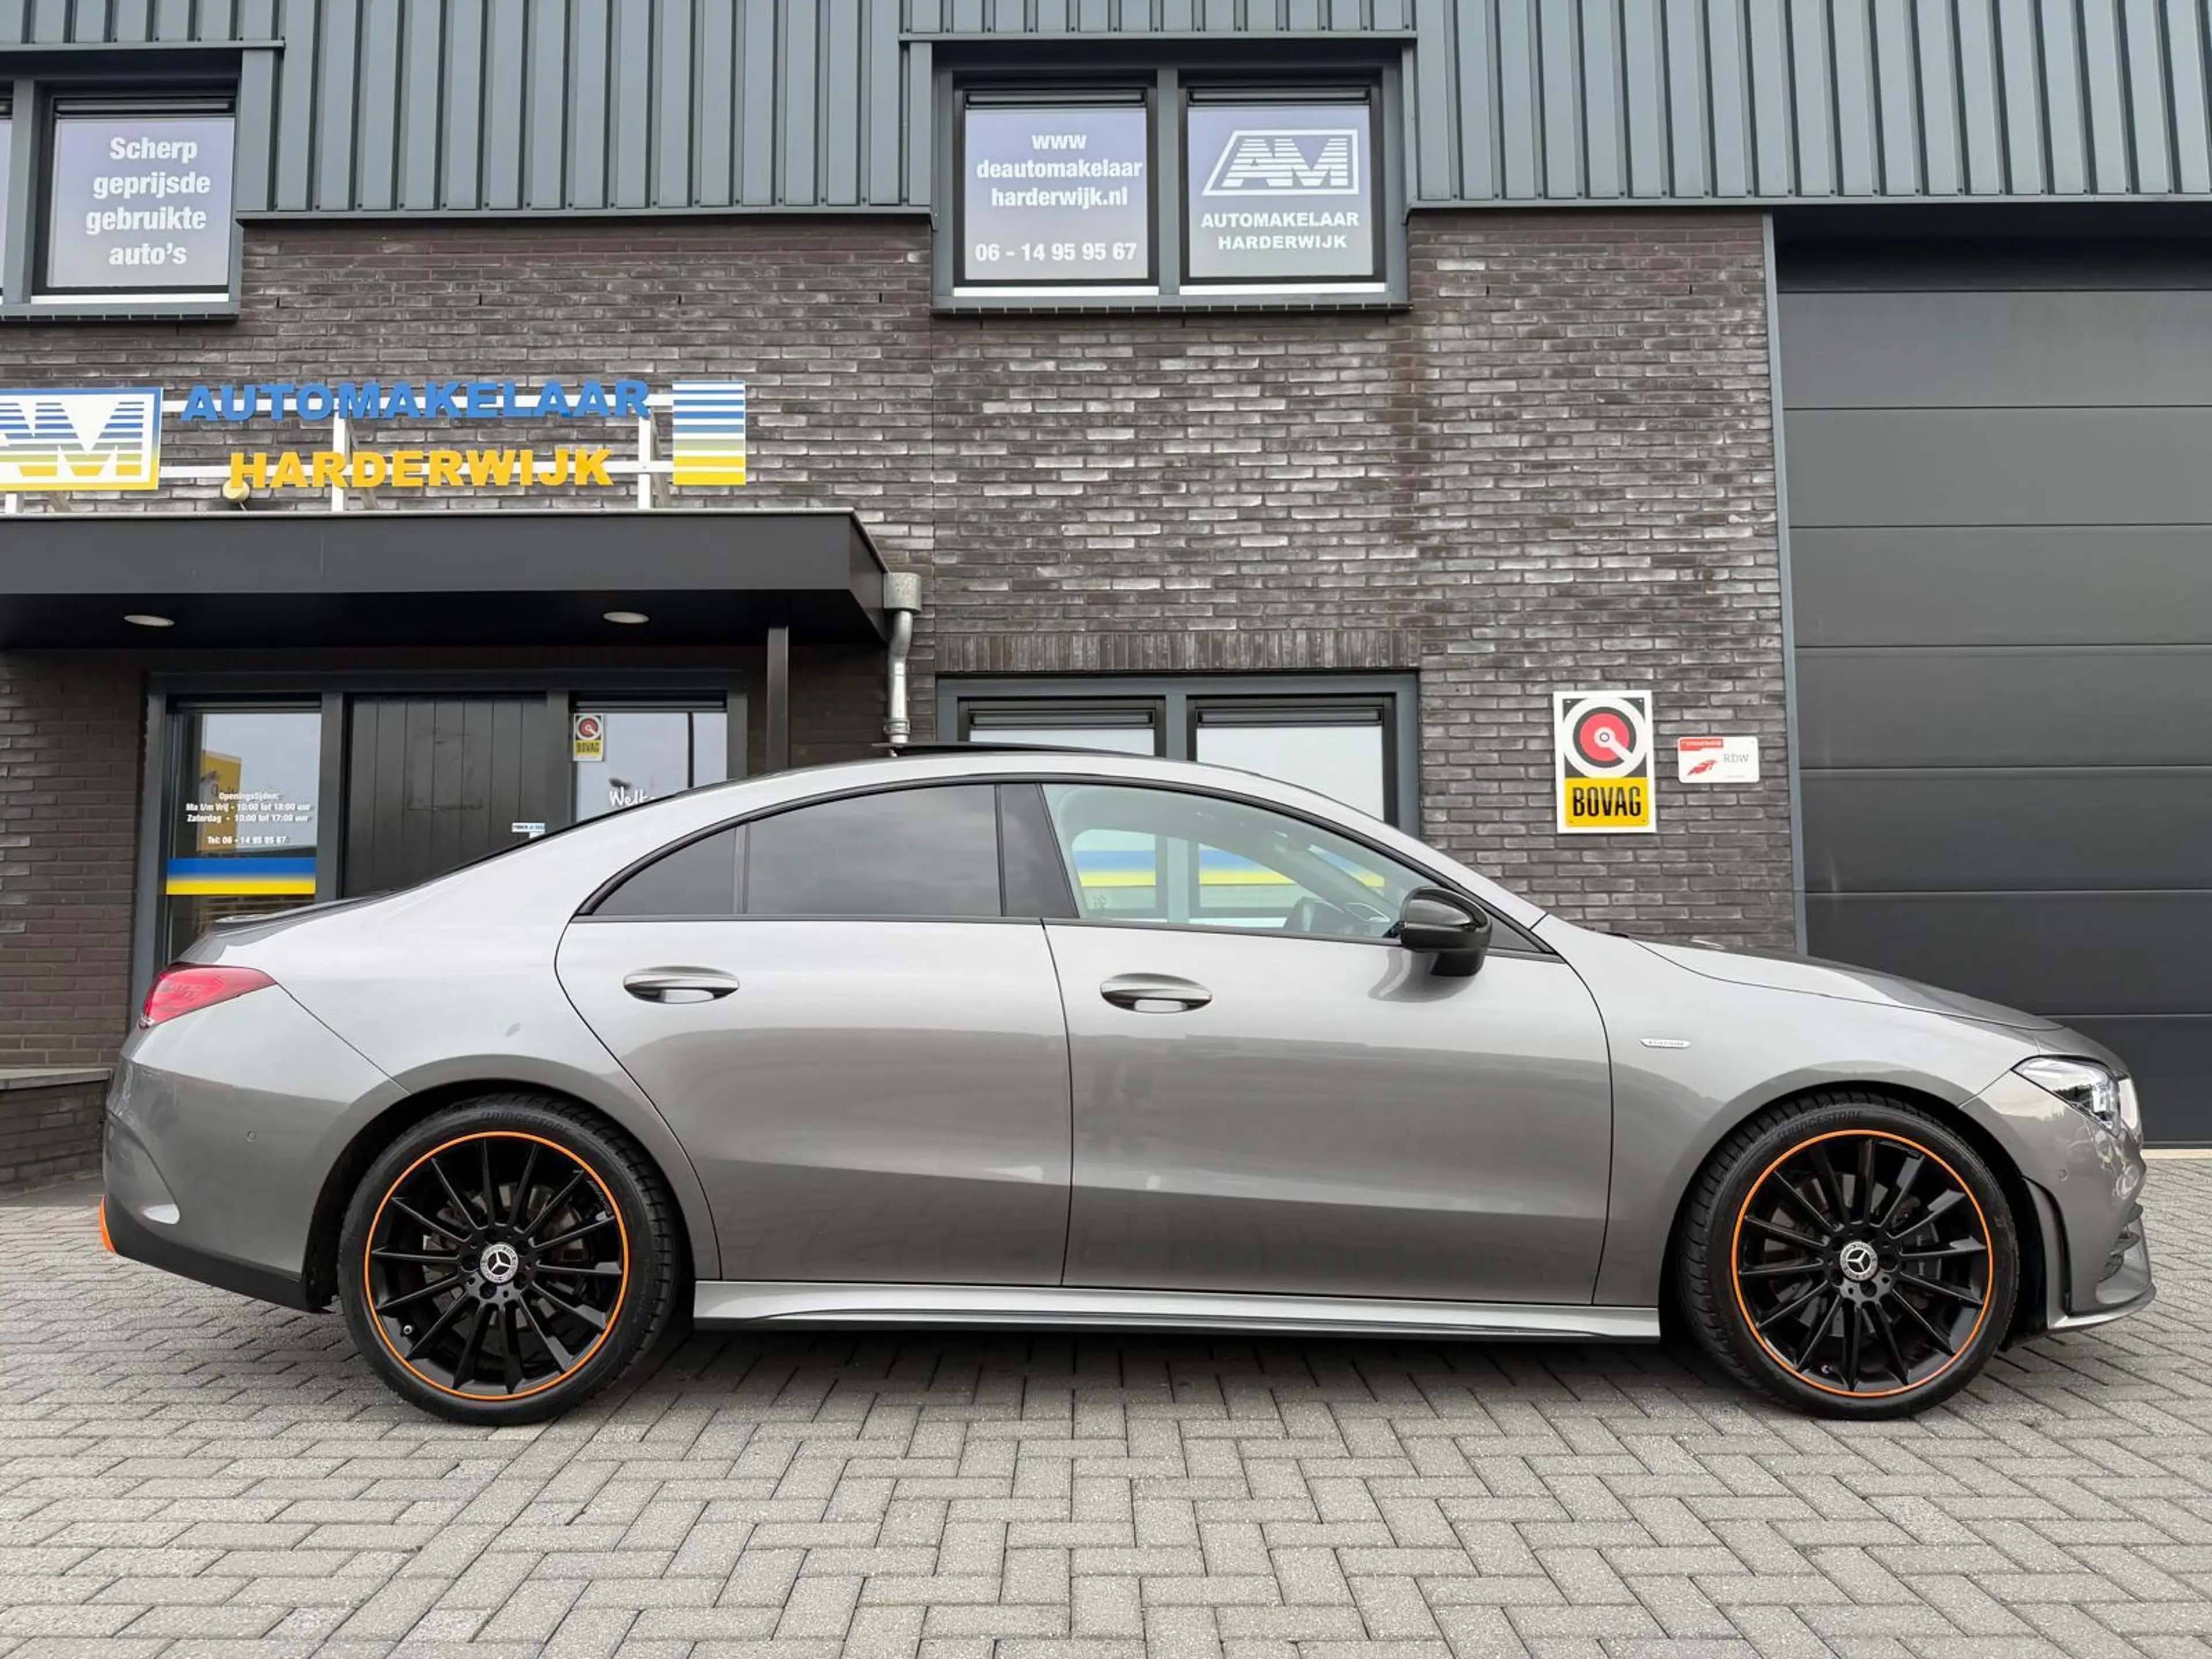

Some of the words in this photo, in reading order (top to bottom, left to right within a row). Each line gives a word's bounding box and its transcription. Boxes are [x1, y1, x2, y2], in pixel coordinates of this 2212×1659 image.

[109, 137, 198, 164] Scherp
[1031, 134, 1088, 150] www
[976, 158, 1143, 178] deautomakelaar
[1221, 138, 1349, 187] AM
[93, 171, 211, 199] geprijsde
[991, 186, 1128, 210] harderwijk.nl
[85, 206, 207, 235] gebruikte
[1200, 211, 1360, 229] AUTOMAKELAAR
[975, 242, 1000, 261] 06
[1021, 242, 1046, 261] 14
[1051, 242, 1075, 261] 95
[1082, 242, 1107, 261] 95
[1112, 242, 1137, 261] 67
[1218, 234, 1347, 250] HARDERWIJK
[181, 380, 650, 421] AUTOMAKELAAR
[229, 448, 612, 489] HARDERWIJK
[577, 741, 600, 753] BOVAG
[1723, 753, 1749, 763] RDW
[609, 786, 657, 806] Welk
[1572, 785, 1642, 817] BOVAG
[187, 814, 222, 824] Zaterdag
[259, 814, 269, 822] tot
[272, 814, 293, 822] 17:00
[240, 836, 250, 844] 14
